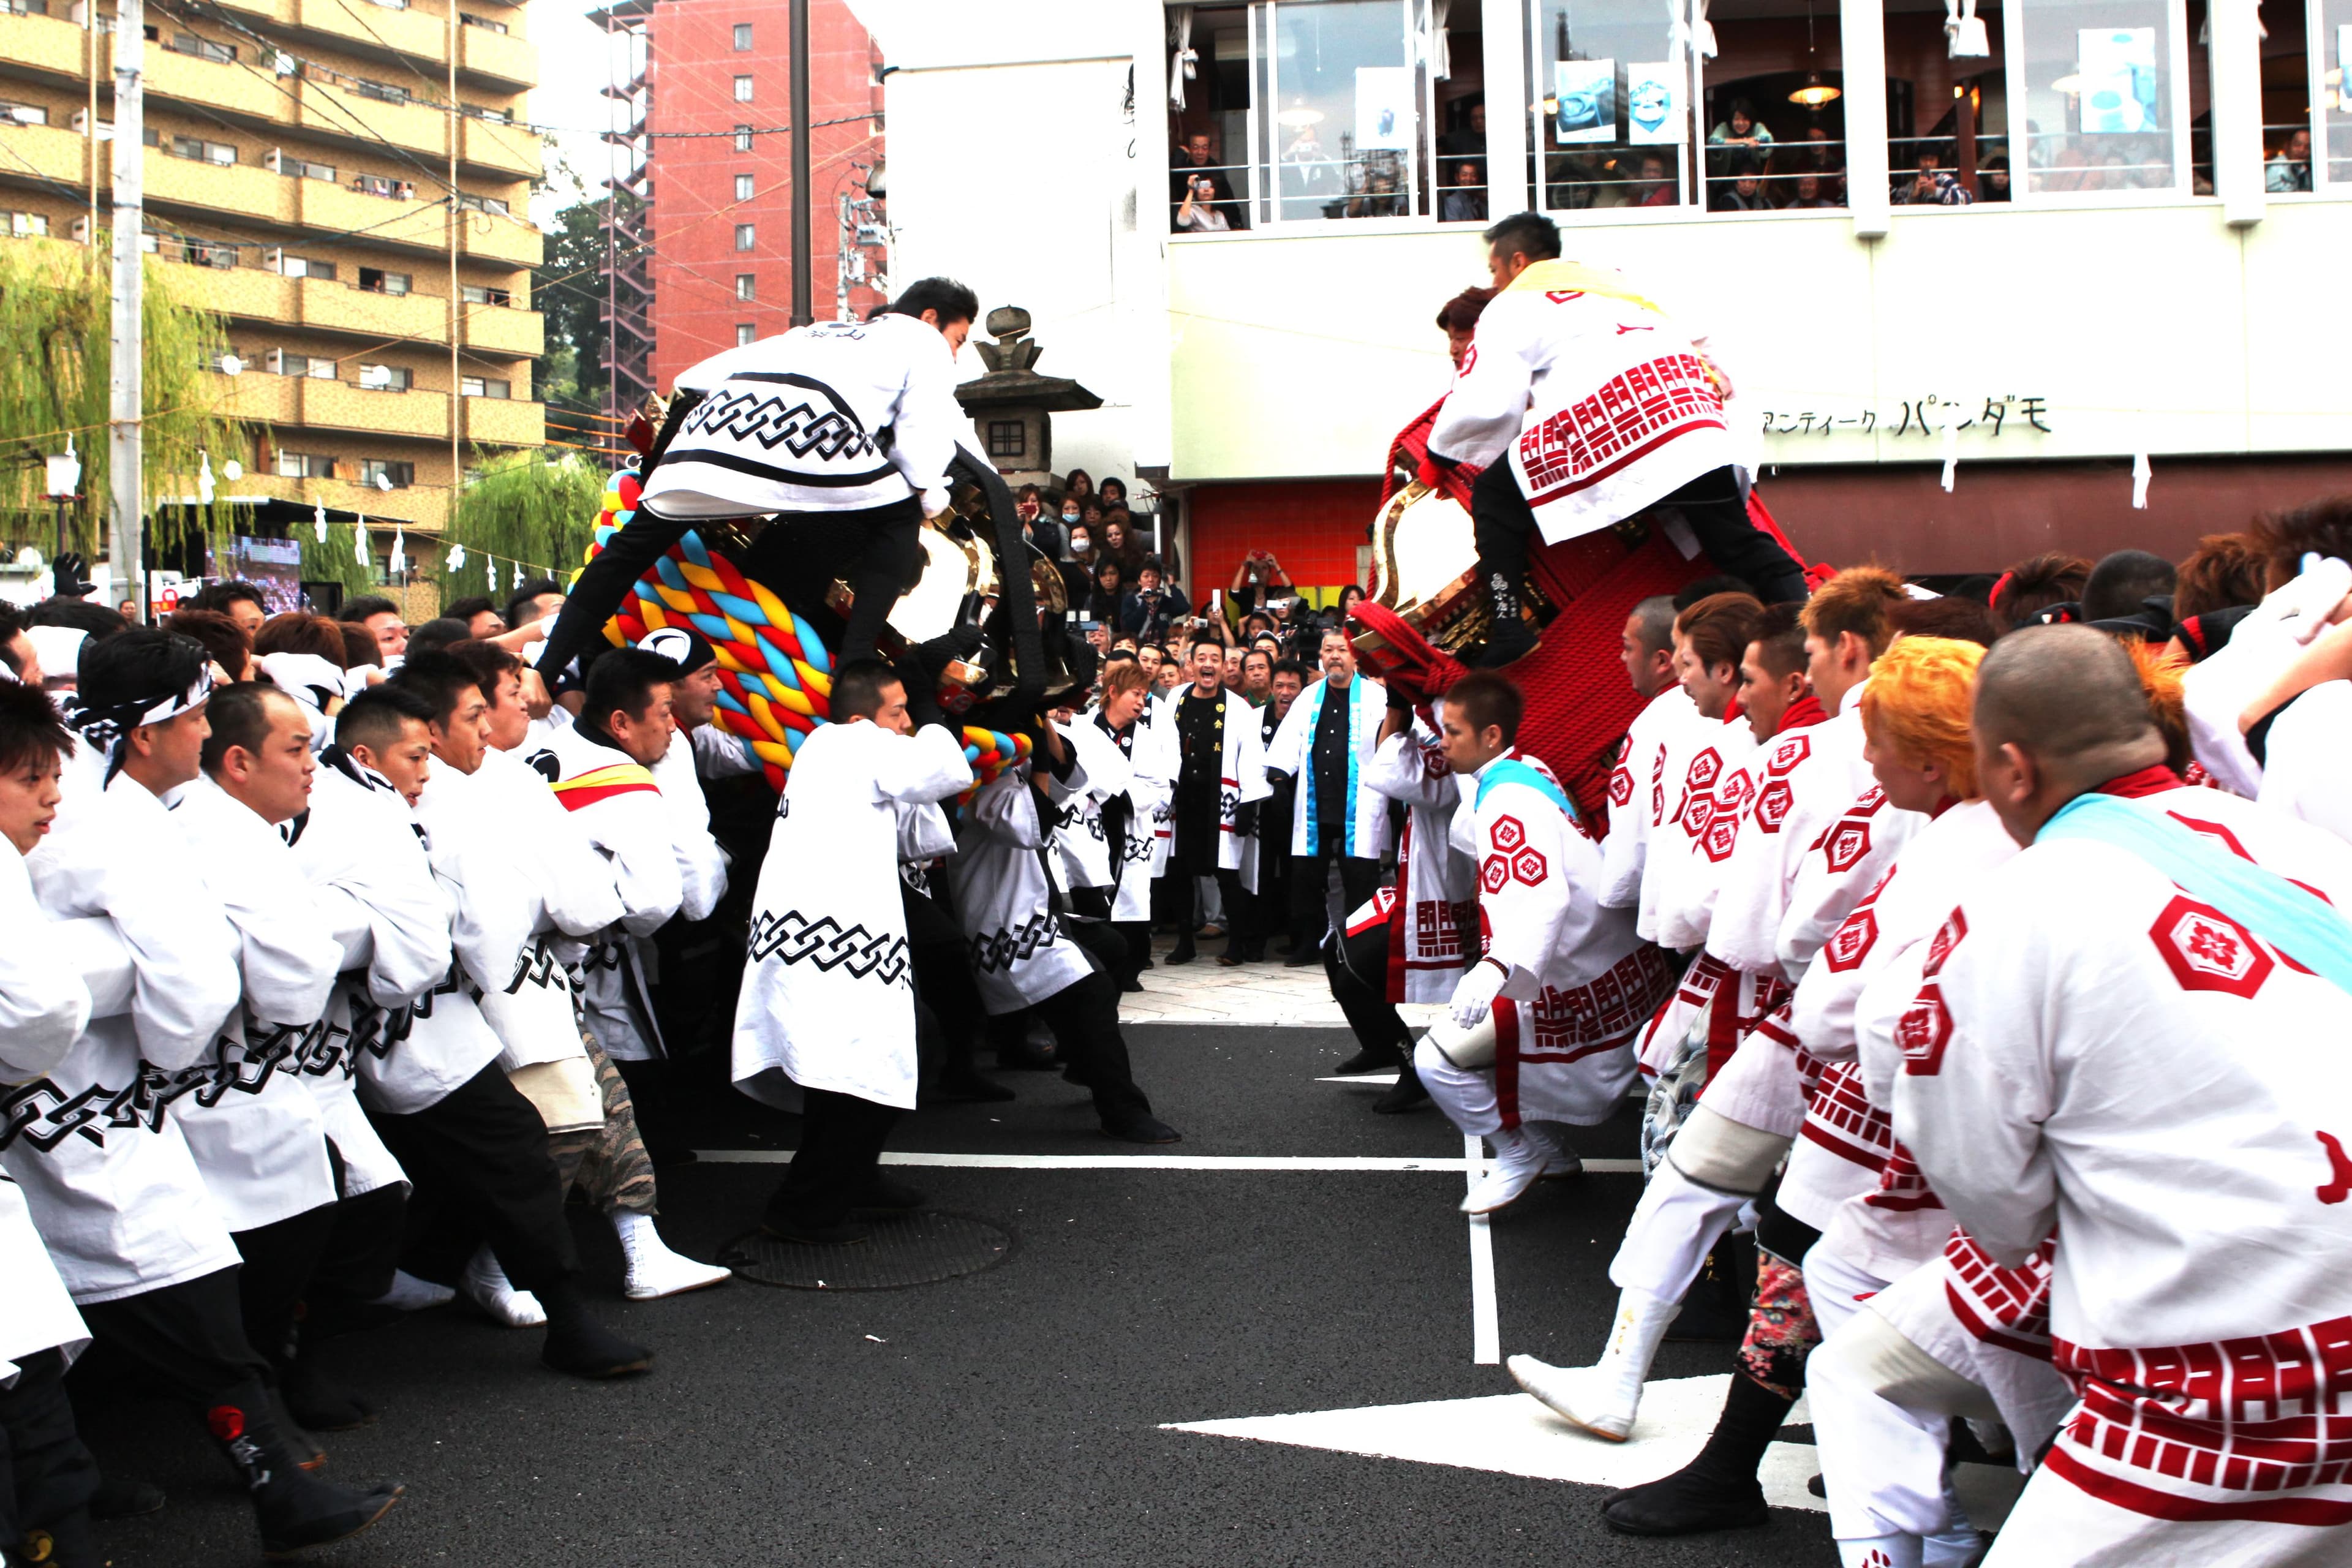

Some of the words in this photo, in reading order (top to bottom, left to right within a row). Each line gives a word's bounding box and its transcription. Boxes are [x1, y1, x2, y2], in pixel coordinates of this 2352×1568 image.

[1762, 410, 1876, 435] アンティーク
[1213, 718, 1224, 752] 会長
